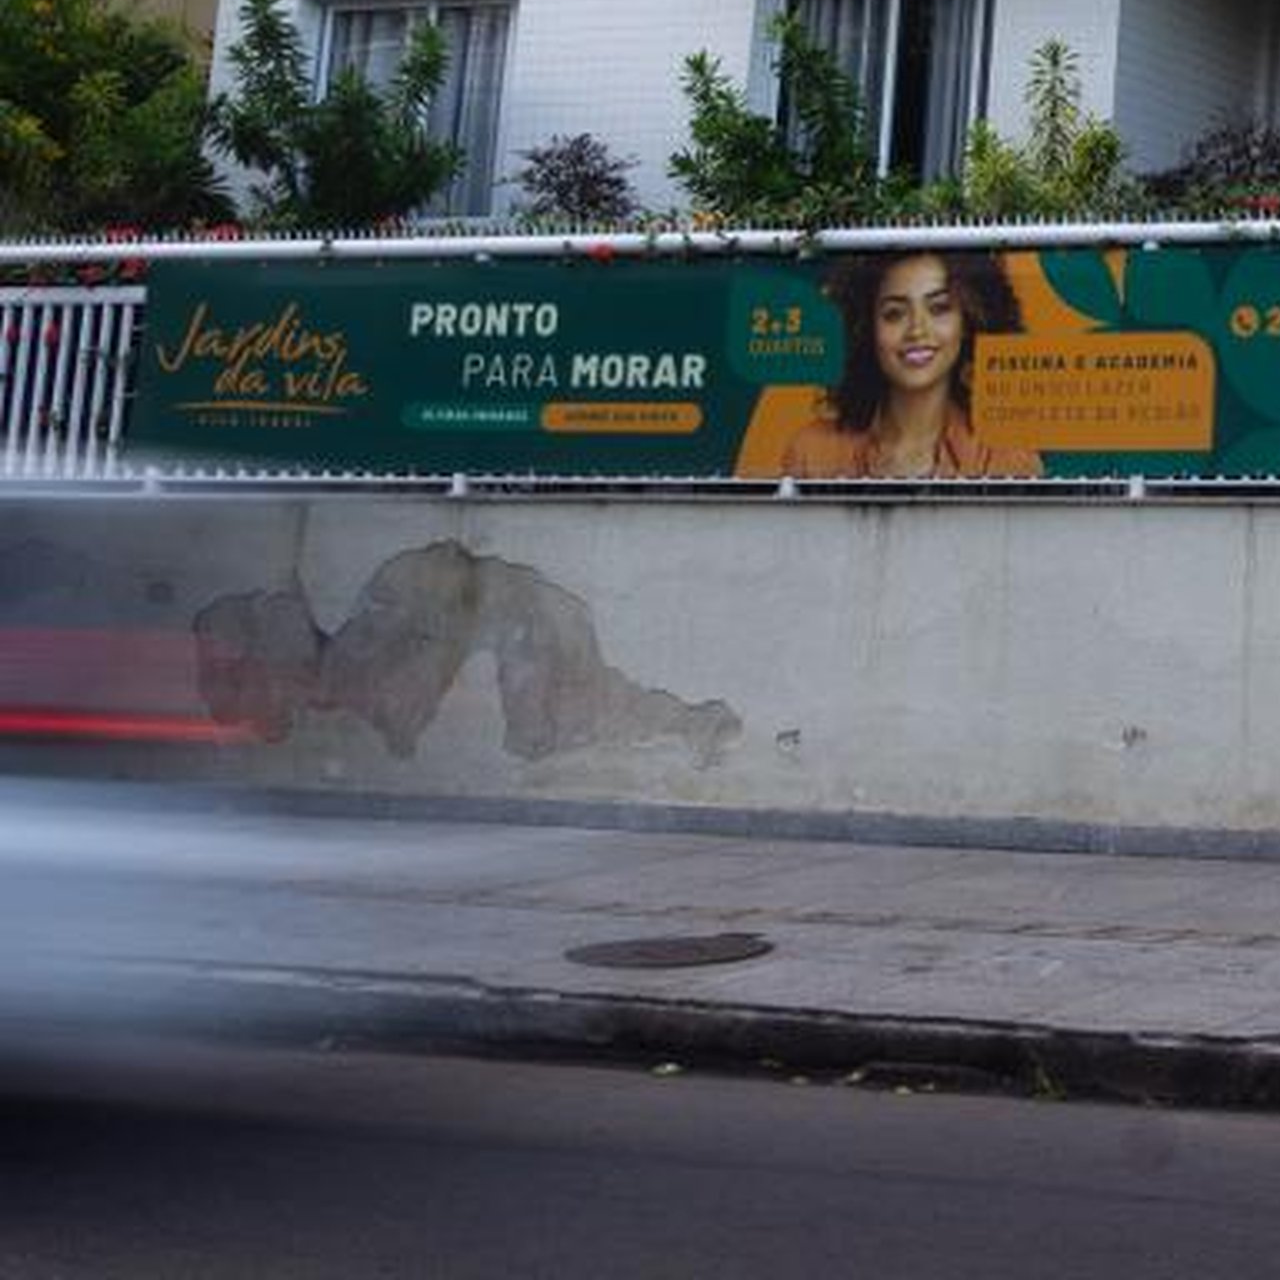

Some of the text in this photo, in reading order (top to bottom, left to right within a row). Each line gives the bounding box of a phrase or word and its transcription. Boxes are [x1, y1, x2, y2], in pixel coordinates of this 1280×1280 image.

[156, 302, 347, 370] Jardins
[409, 303, 558, 336] PRONTO
[214, 349, 369, 400] da vila
[461, 353, 706, 388] PARA MORAR
[986, 355, 1066, 371] PISCINA
[1095, 354, 1199, 370] ACADEMIA
